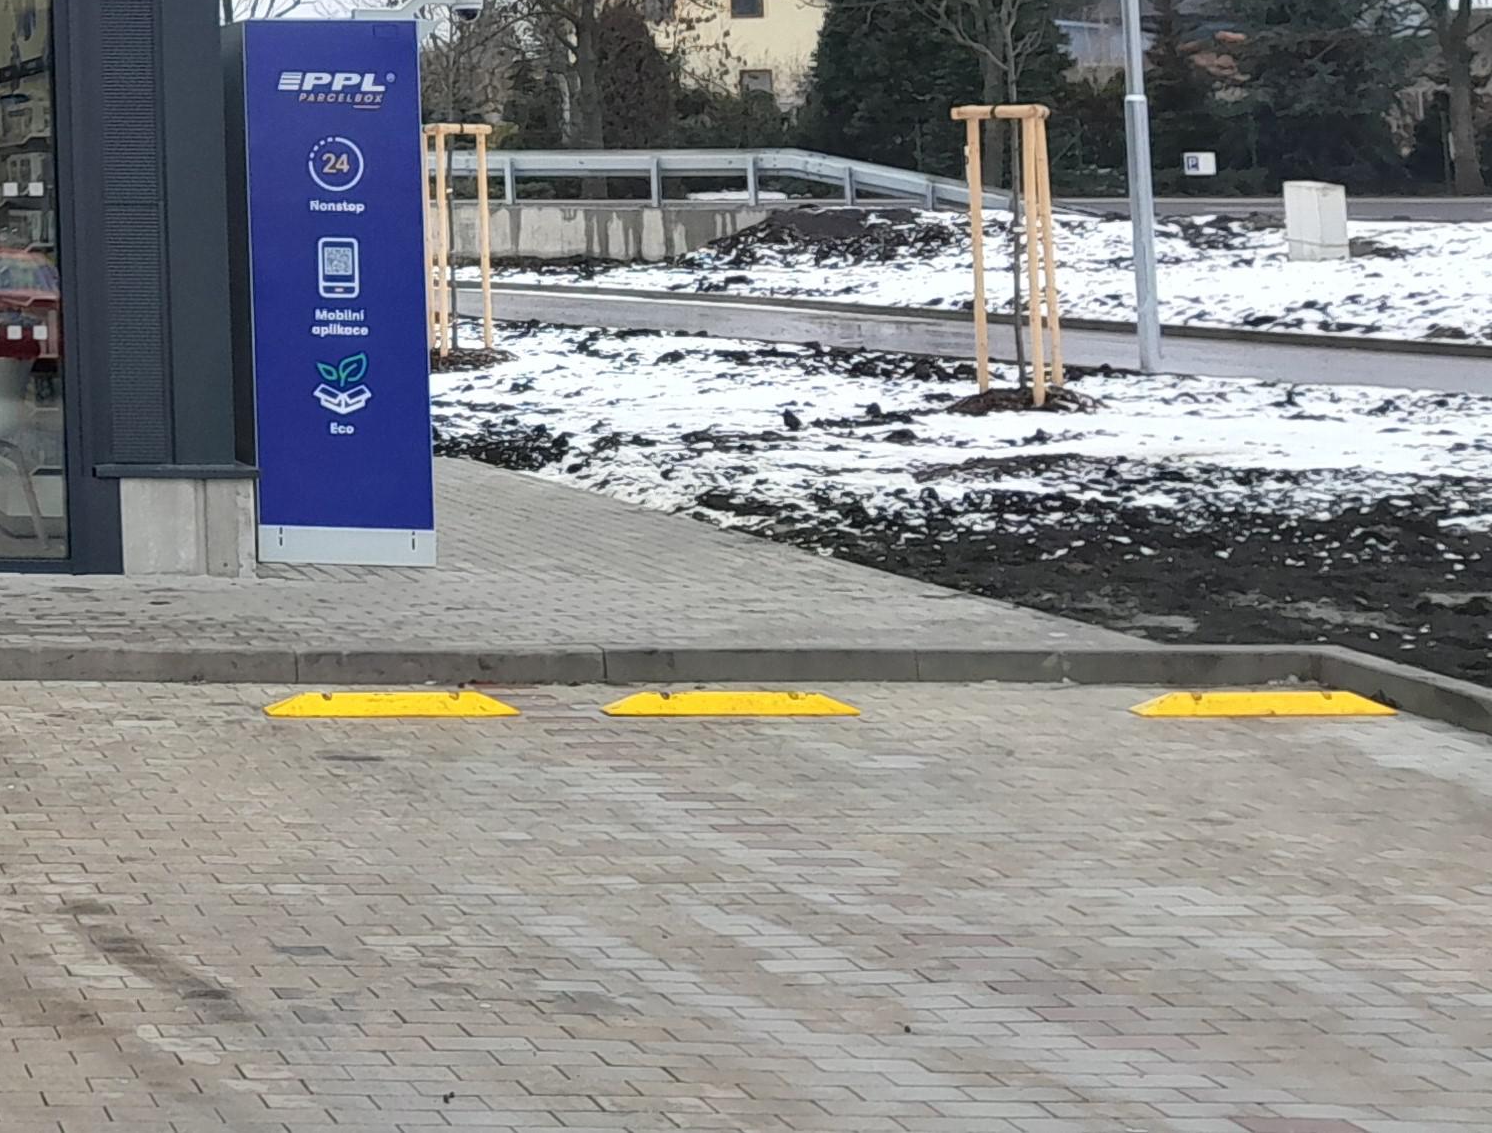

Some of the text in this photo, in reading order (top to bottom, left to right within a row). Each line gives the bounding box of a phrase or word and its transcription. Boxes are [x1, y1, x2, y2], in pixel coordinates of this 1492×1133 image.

[302, 72, 386, 92] PPL
[298, 93, 383, 103] PARCELBOX
[322, 153, 350, 174] 24
[309, 200, 365, 214] Nonstop
[315, 309, 365, 321] Mobilní
[311, 323, 368, 337] aplikace
[330, 422, 355, 434] Eco
